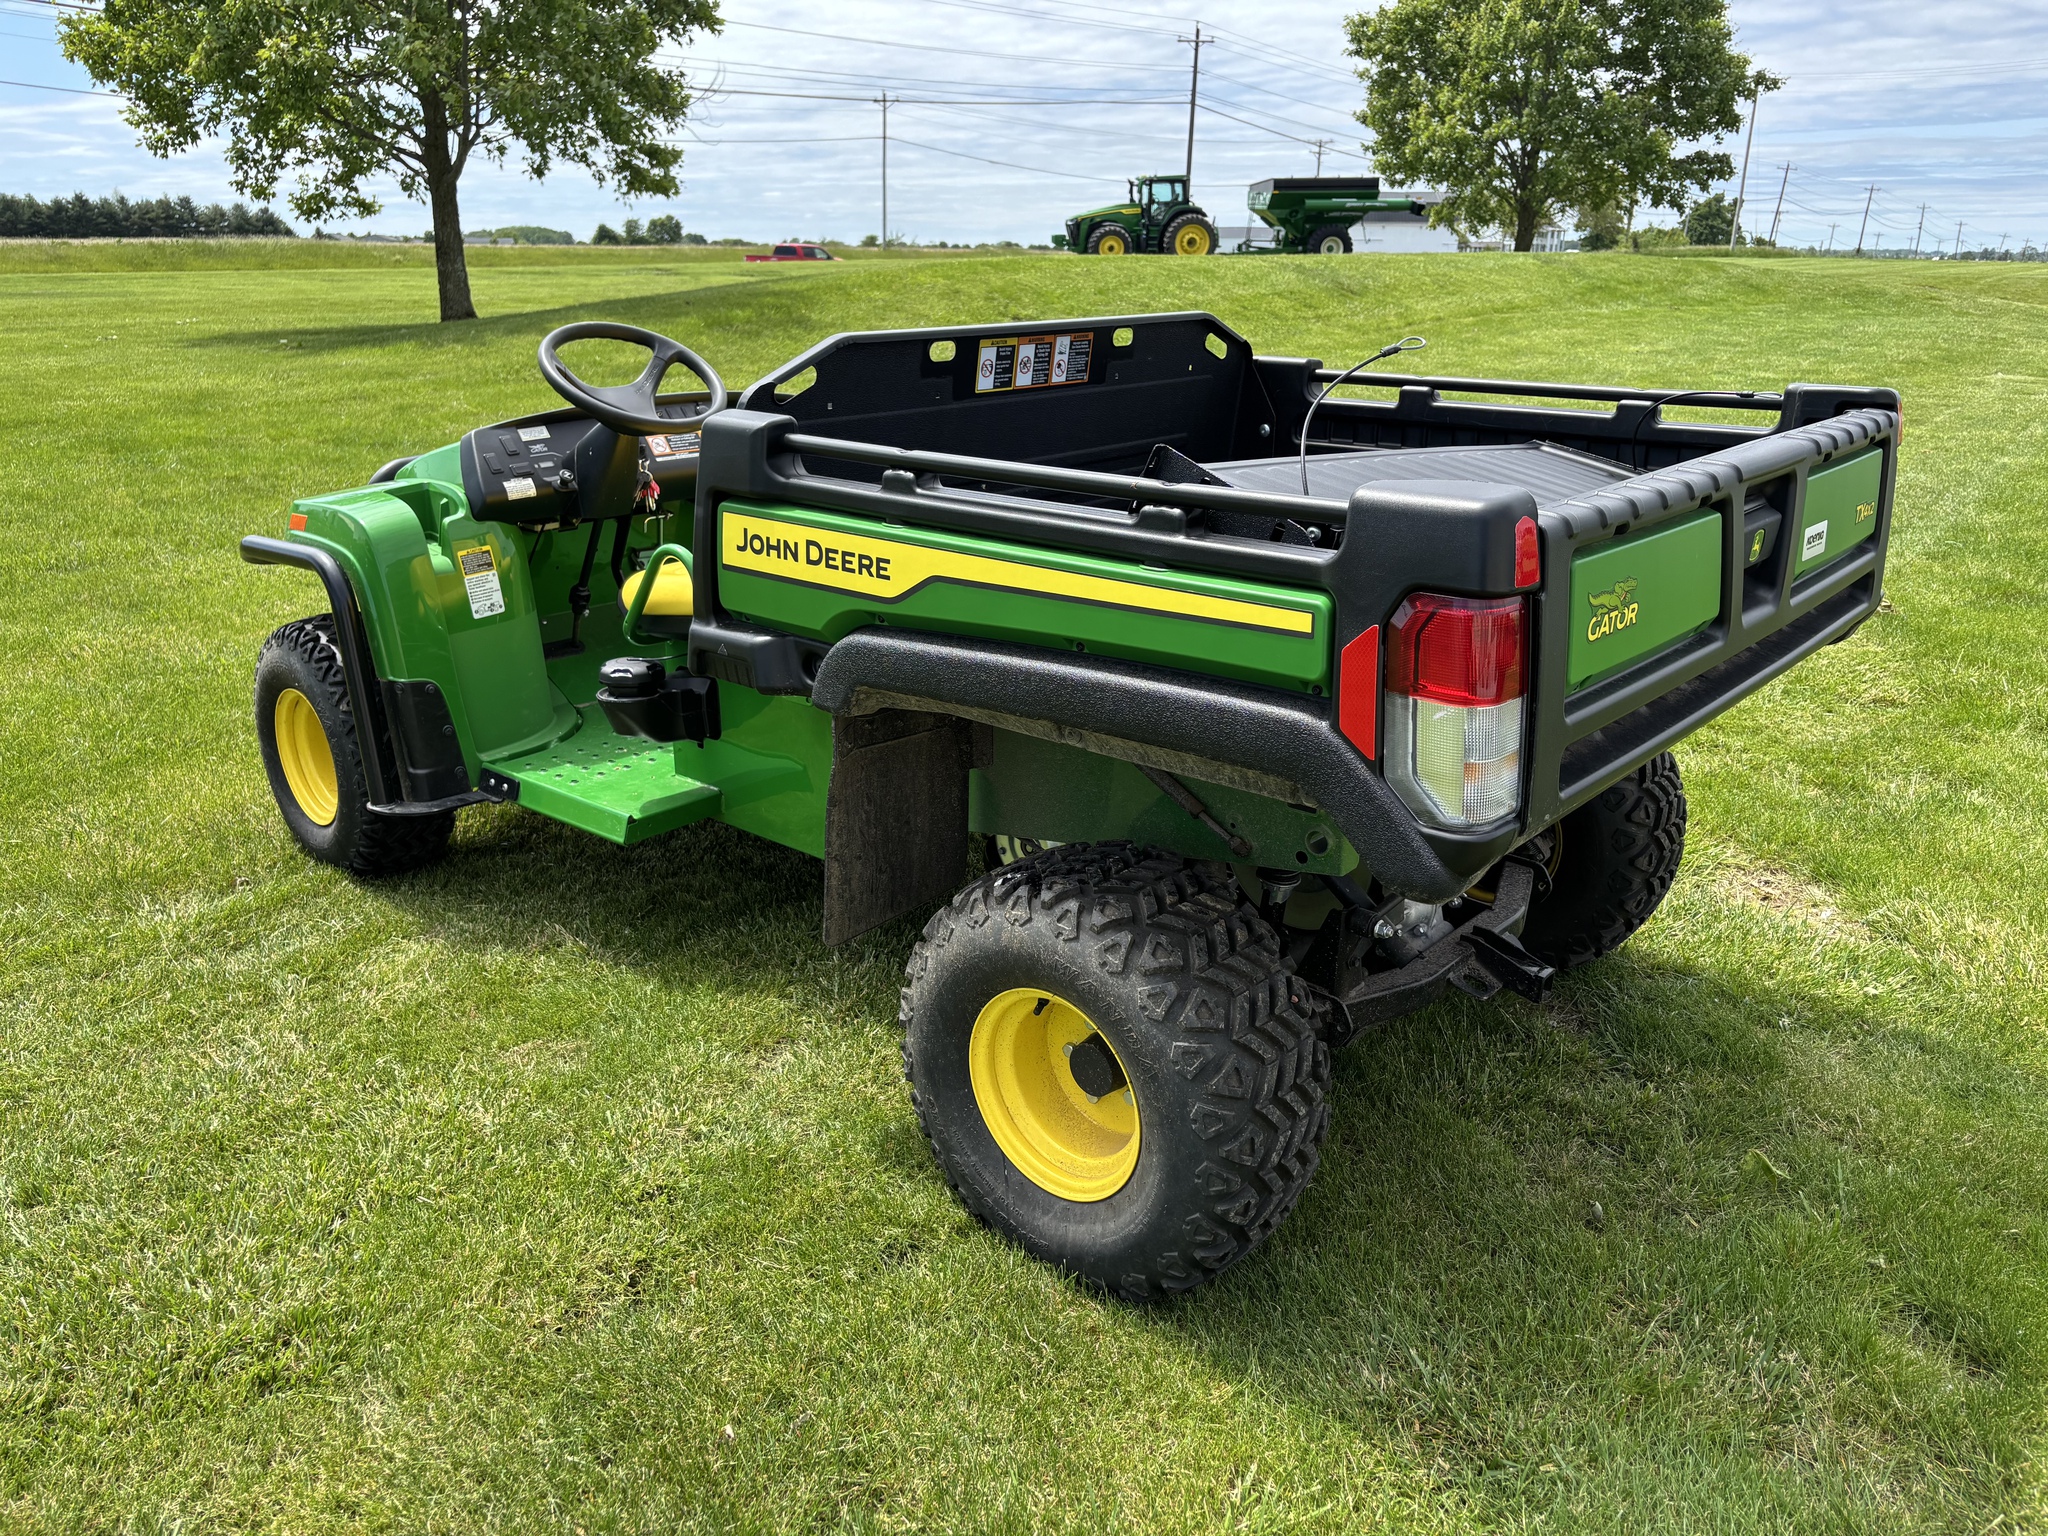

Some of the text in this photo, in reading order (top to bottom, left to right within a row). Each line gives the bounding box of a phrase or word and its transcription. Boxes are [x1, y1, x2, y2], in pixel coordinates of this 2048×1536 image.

[736, 528, 891, 581] JOHN DEERE
[1587, 603, 1639, 642] GATOR
